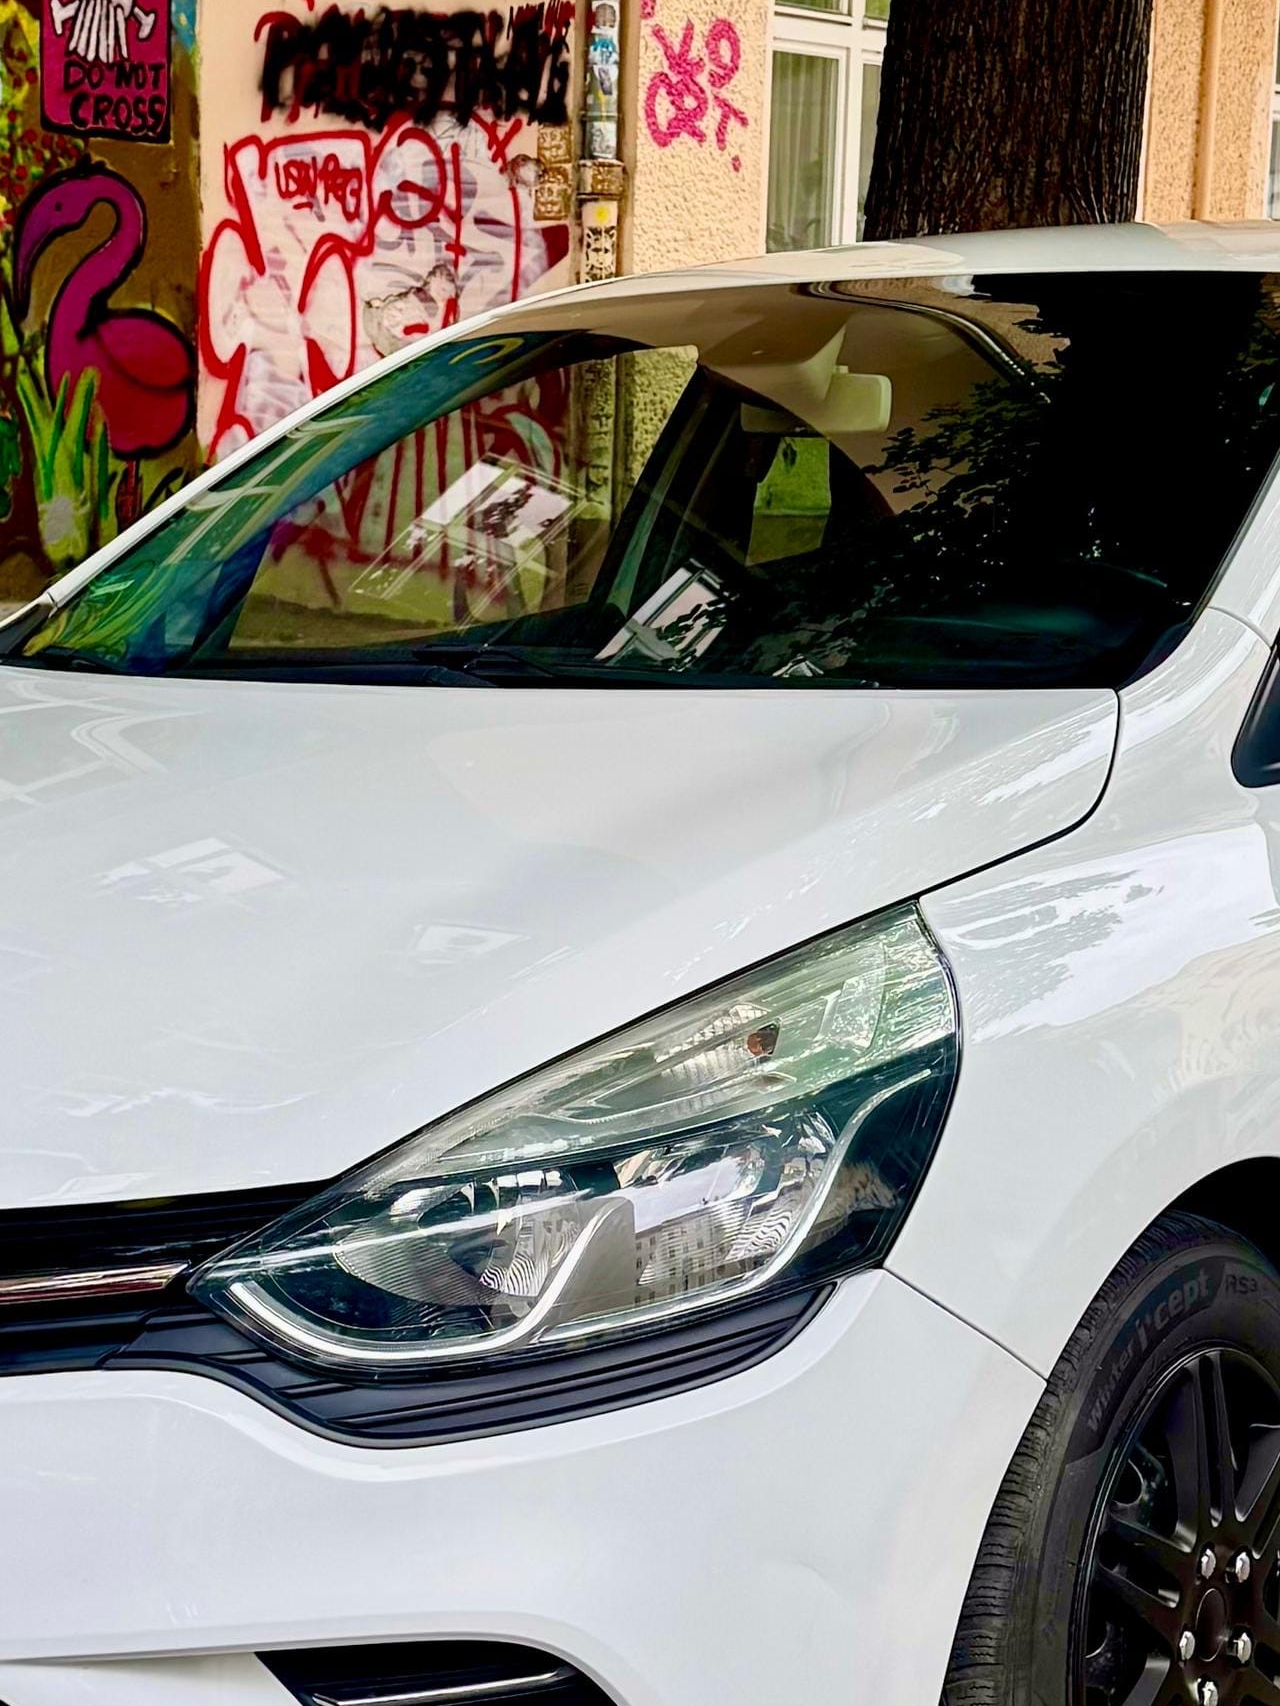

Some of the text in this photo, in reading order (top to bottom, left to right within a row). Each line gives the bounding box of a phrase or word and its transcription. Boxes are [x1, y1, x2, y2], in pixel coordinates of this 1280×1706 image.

[64, 60, 166, 91] DO NOT
[71, 93, 166, 133] CROSS
[1225, 1273, 1259, 1294] RS3
